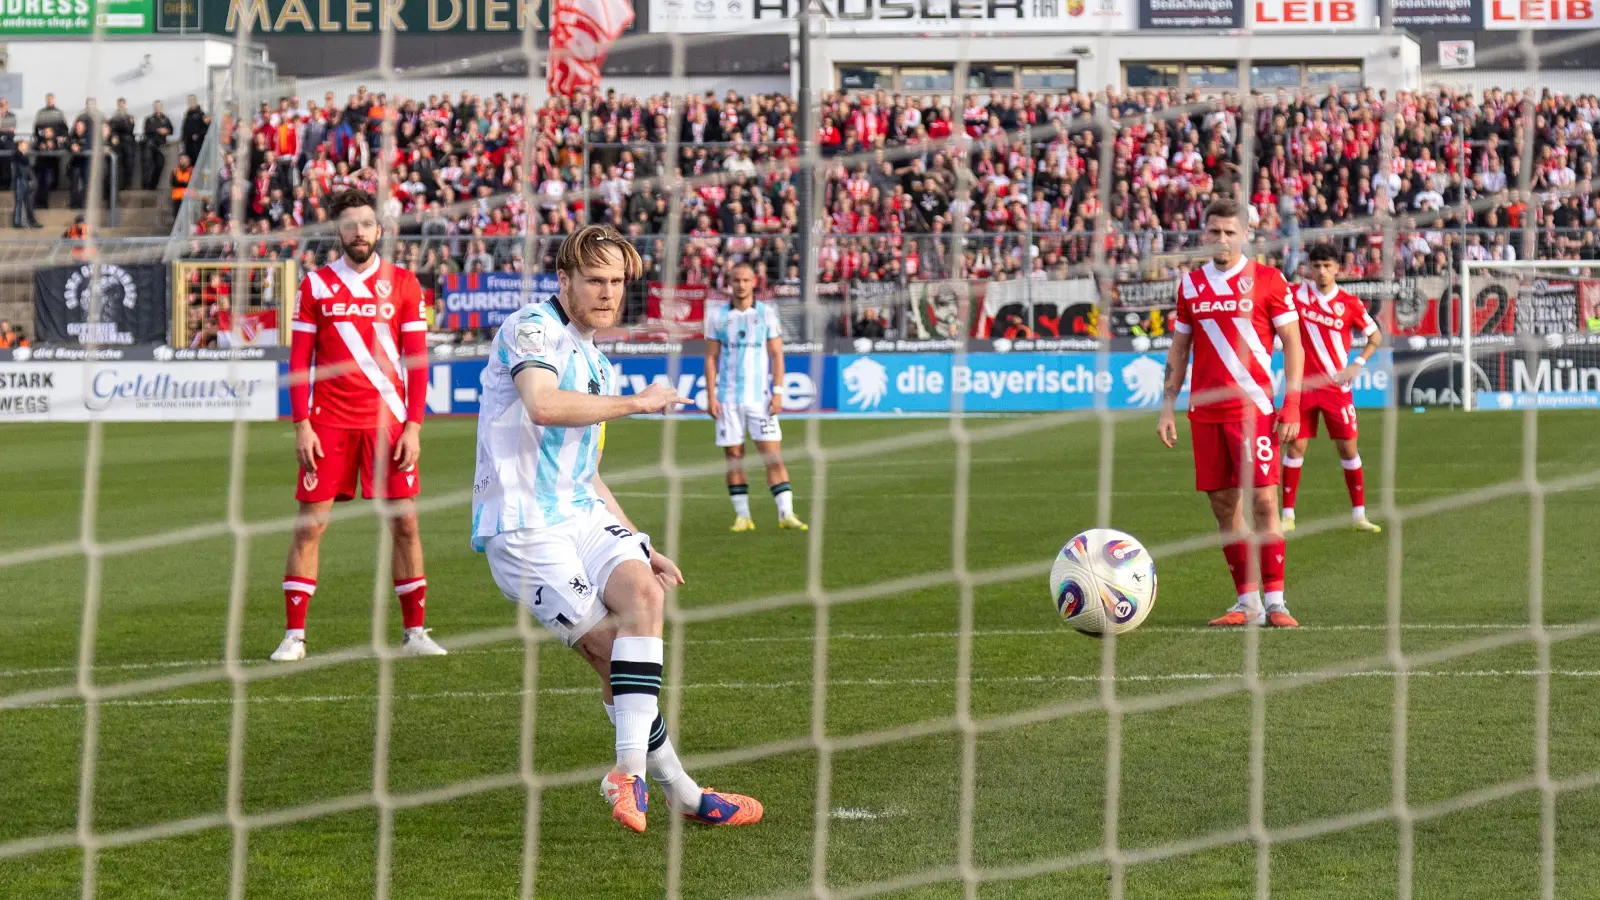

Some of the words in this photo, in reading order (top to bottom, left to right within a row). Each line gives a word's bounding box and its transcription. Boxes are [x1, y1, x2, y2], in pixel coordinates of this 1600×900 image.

[0, 0, 89, 15] DRESS
[1255, 0, 1357, 23] LEIB
[1492, 0, 1594, 21] LEIB
[225, 0, 408, 32] MALER
[427, 0, 553, 31] DIER
[874, 340, 895, 351] die
[1014, 339, 1035, 350] die
[1428, 337, 1449, 347] die
[1566, 334, 1587, 345] die
[32, 348, 55, 360] die
[55, 347, 124, 361] Bayerische
[174, 348, 197, 360] die
[197, 347, 265, 361] Bayerische
[614, 342, 683, 355] Bayerische
[0, 371, 54, 389] STARK
[896, 365, 944, 394] die
[952, 364, 1113, 399] Bayerische
[84, 368, 261, 411] Geldhauser
[1340, 403, 1357, 426] 19
[1243, 435, 1273, 462] 18
